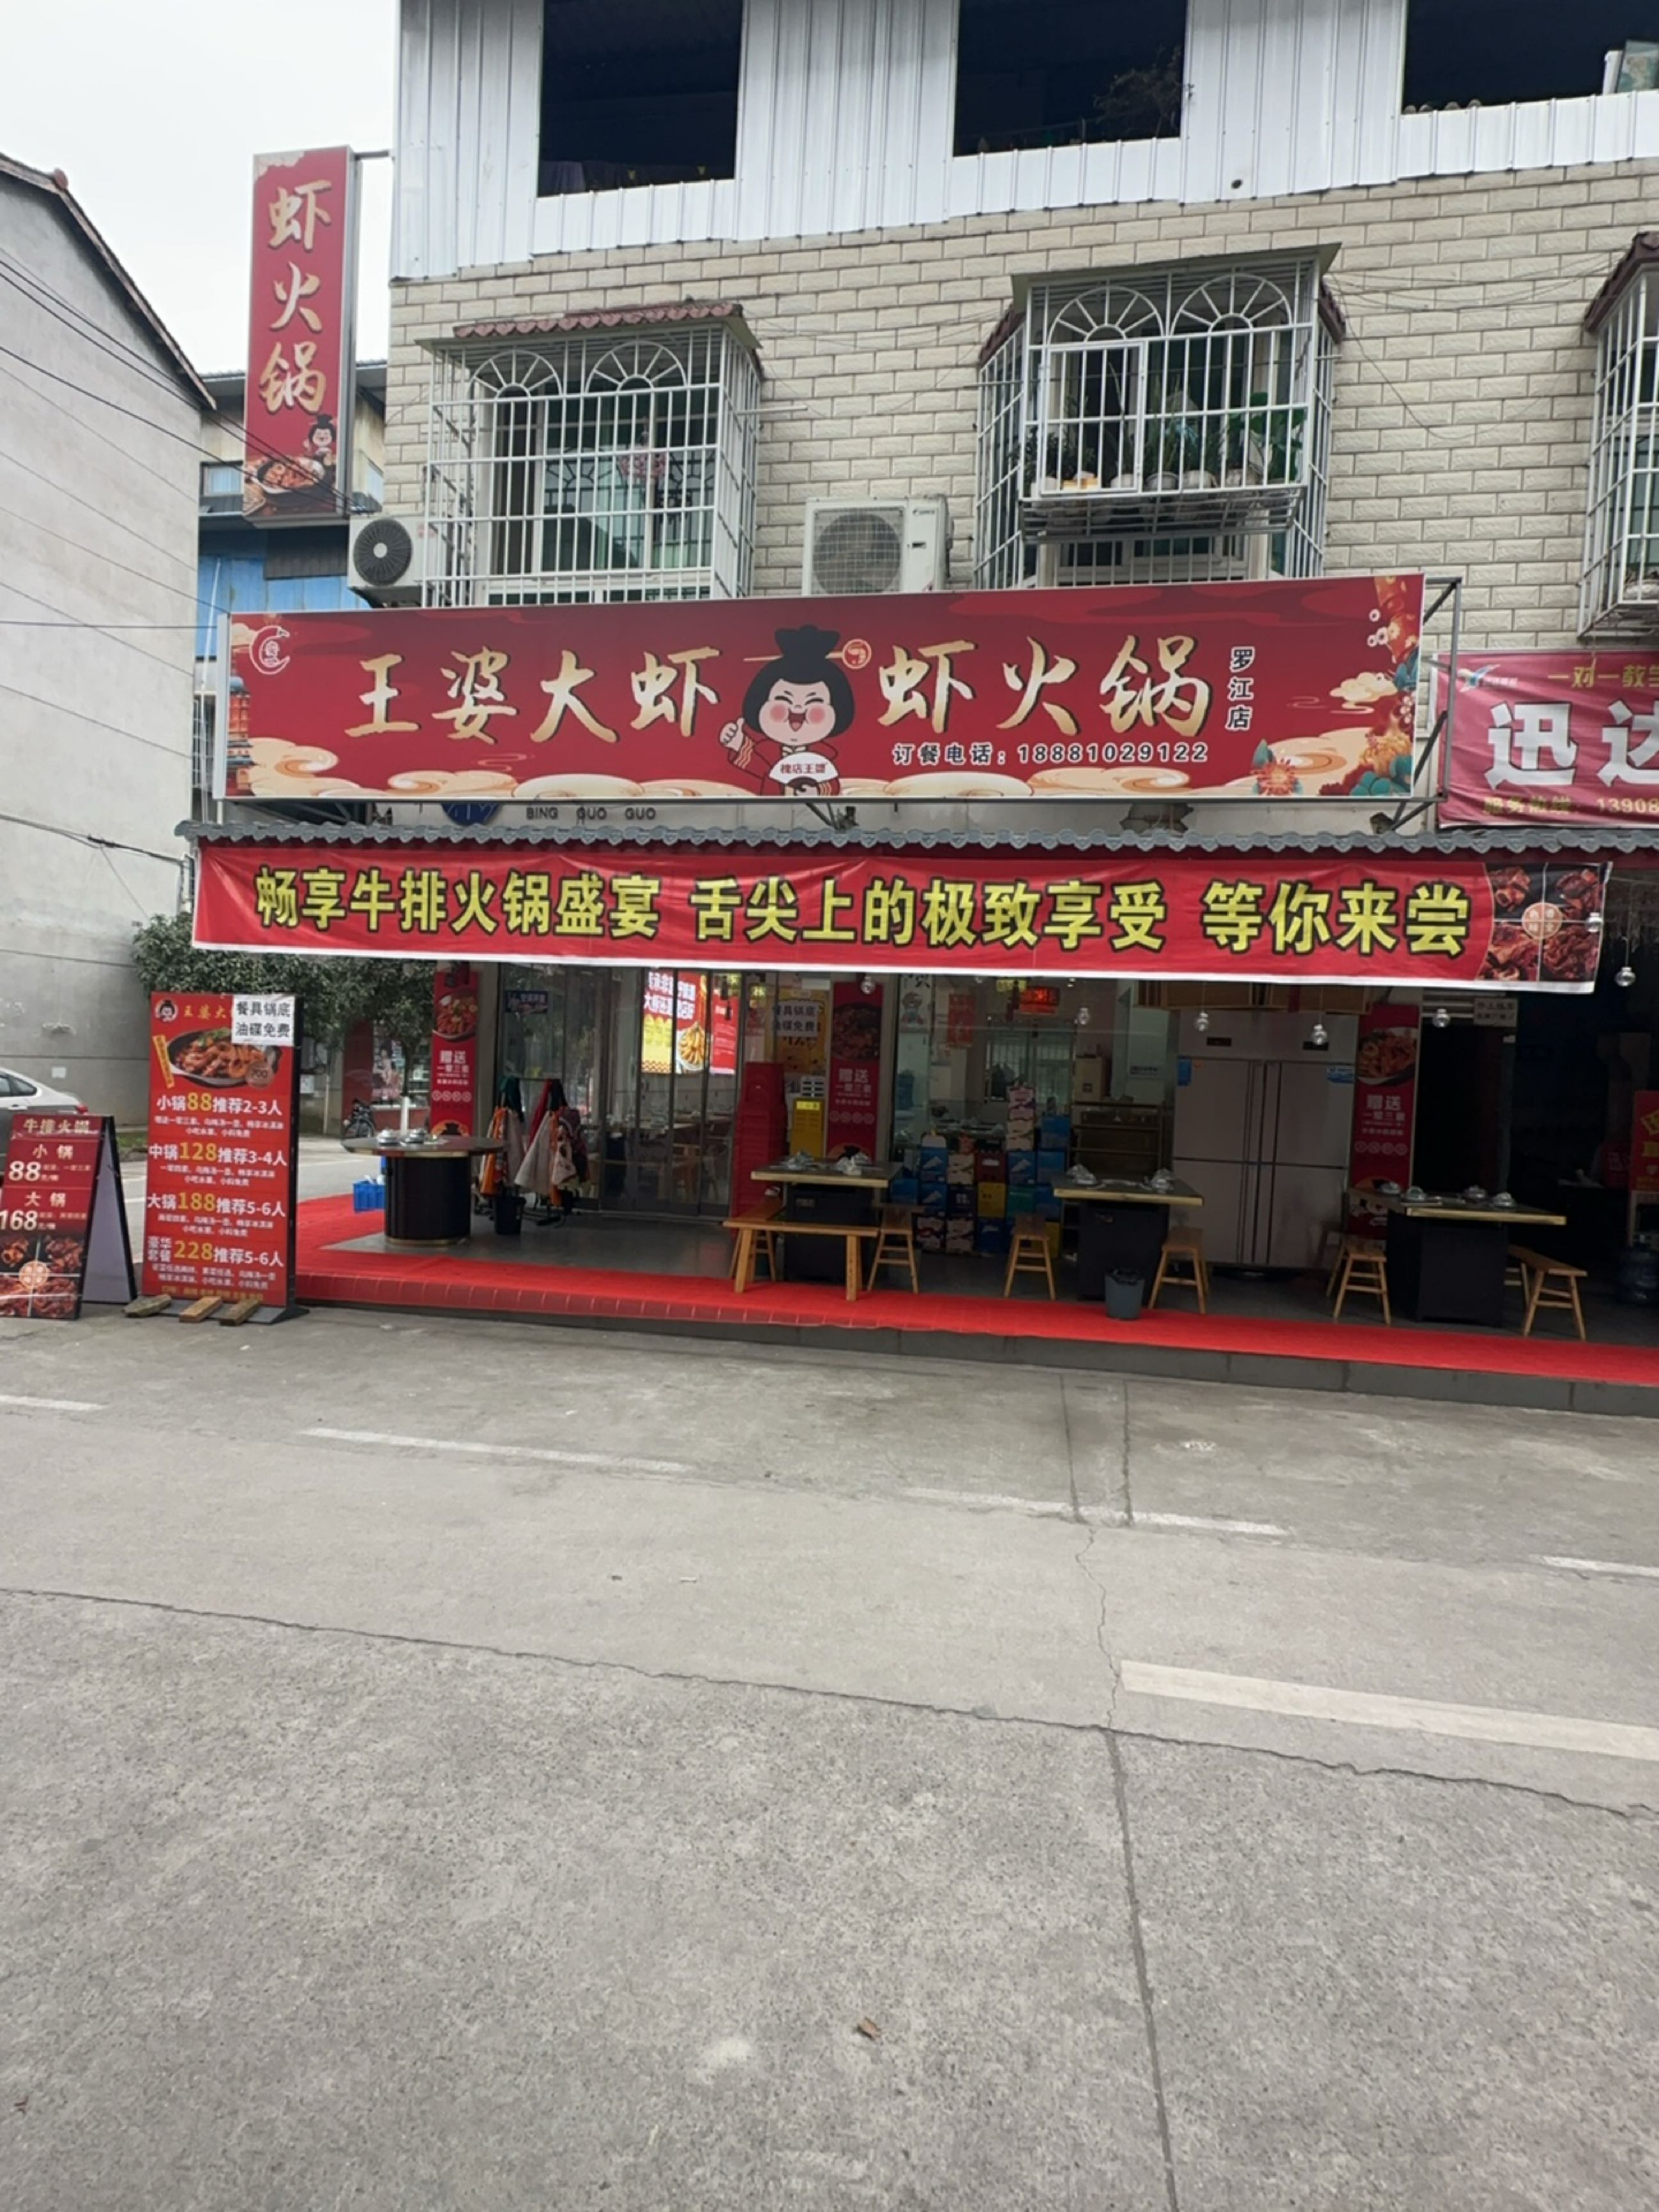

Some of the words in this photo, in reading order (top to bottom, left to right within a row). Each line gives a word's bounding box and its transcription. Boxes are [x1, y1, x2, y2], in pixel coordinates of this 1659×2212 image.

[258, 179, 332, 413] 虾火锅
[344, 646, 719, 744] 王婆大虾
[877, 635, 1212, 736] 虾火锅
[1226, 646, 1255, 731] 罗江店
[526, 808, 558, 819] BING
[577, 808, 607, 820] GUO
[625, 808, 656, 820] GUO
[255, 866, 661, 938] 畅享牛排火锅盛宴
[689, 875, 1166, 951] 舌尖上的极致享受
[1202, 881, 1470, 956] 等你来尝
[236, 1000, 291, 1017] 餐具锅底
[236, 1022, 290, 1038] 油碟免费
[8, 1161, 42, 1182] 88
[0, 1210, 38, 1230] 168
